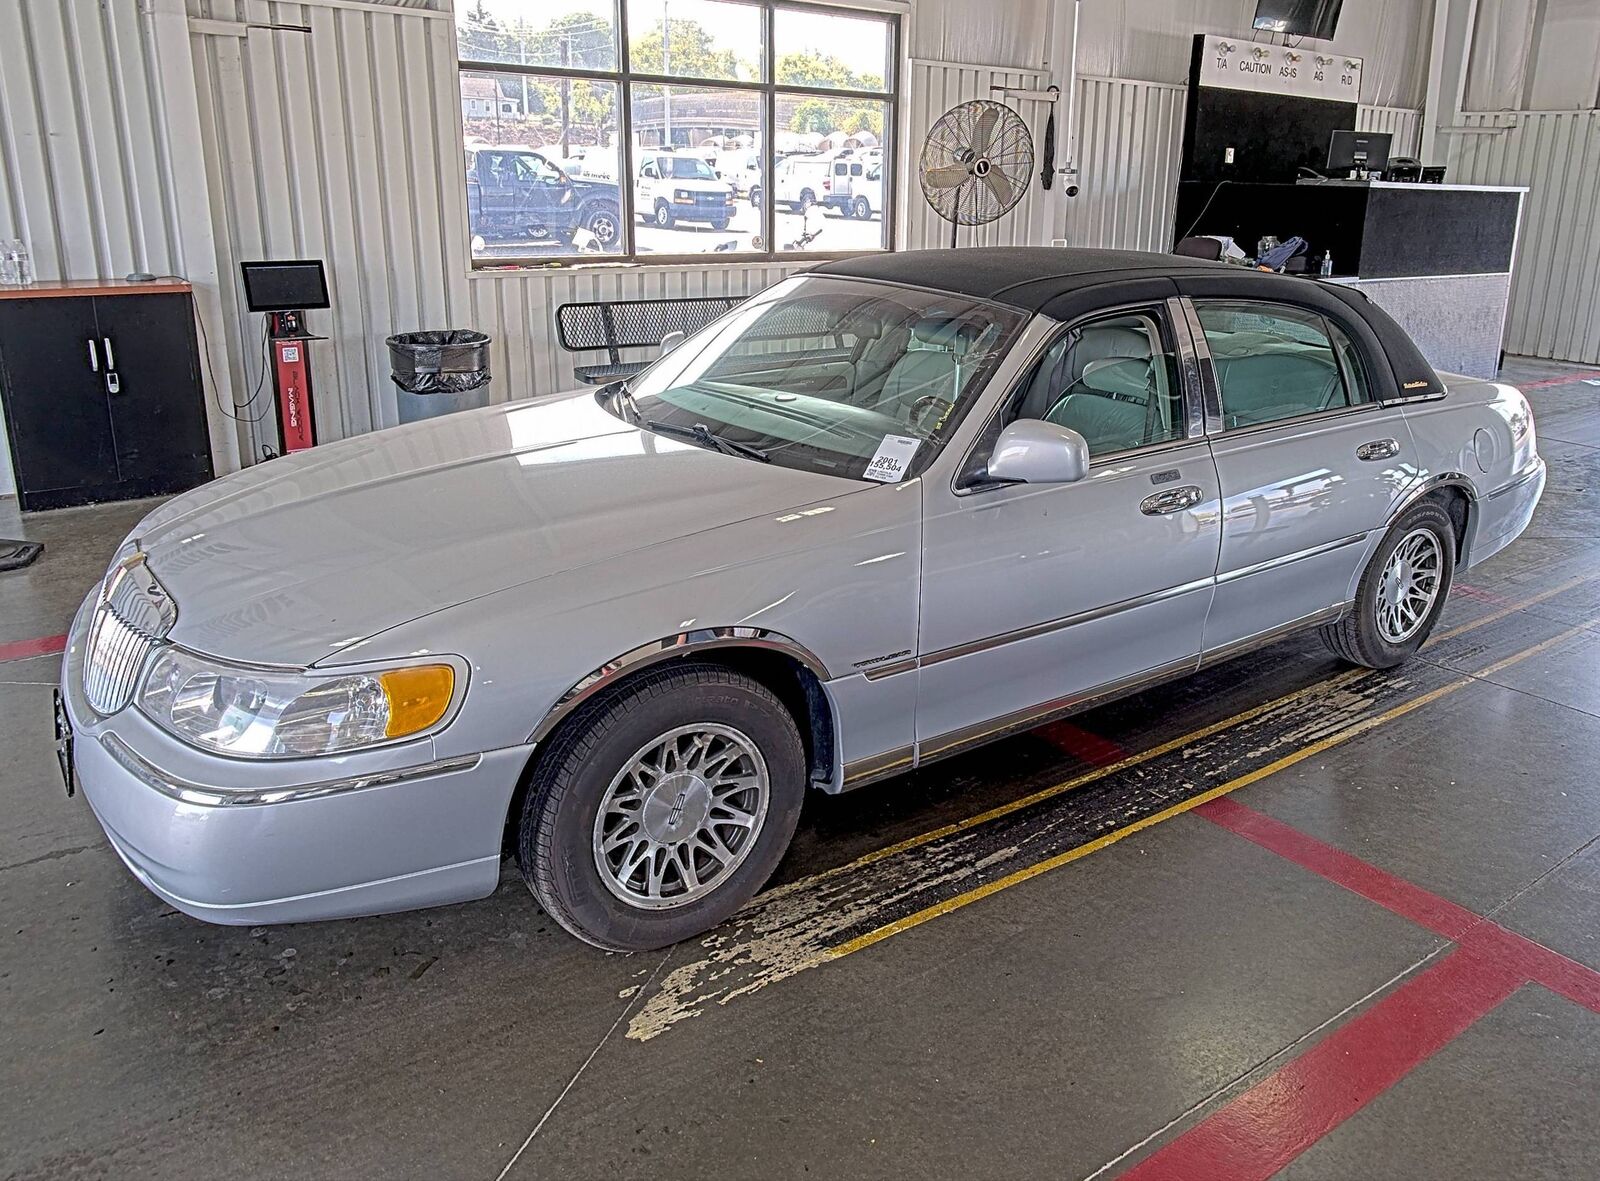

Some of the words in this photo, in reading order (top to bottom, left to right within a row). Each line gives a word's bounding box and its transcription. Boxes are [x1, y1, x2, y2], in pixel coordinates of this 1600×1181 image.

[1216, 57, 1228, 69] T/A
[1239, 60, 1272, 75] CAUTION
[1278, 66, 1297, 79] AS-IS
[1313, 71, 1324, 82] AG
[287, 387, 298, 427] IMAGING
[869, 460, 902, 472] 155,504
[877, 455, 899, 466] 2001
